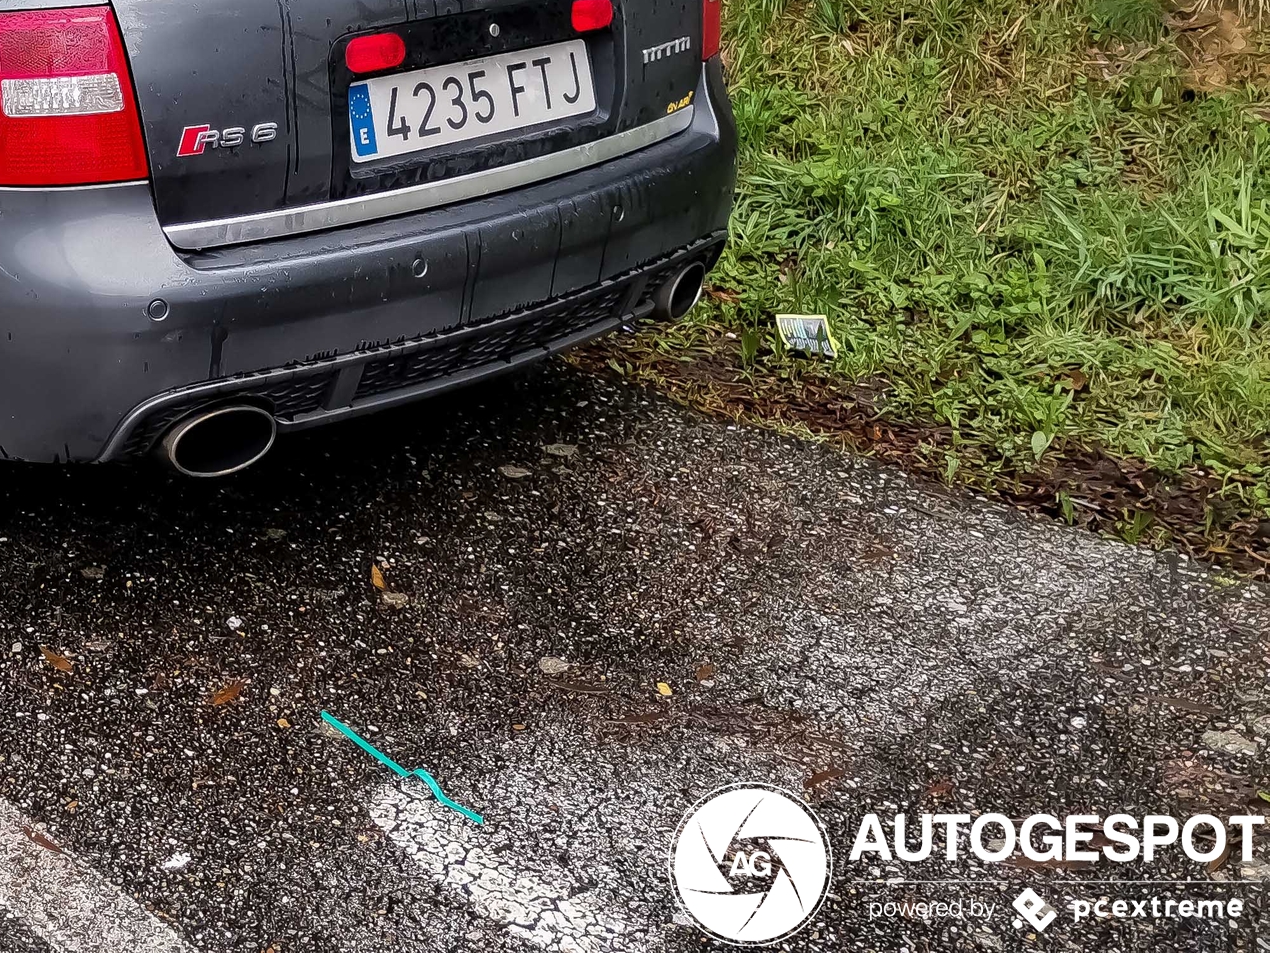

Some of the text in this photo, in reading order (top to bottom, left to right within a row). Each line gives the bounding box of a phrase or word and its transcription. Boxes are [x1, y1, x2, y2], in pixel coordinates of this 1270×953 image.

[360, 51, 581, 145] E 4235 FTJ
[251, 122, 278, 143] 6
